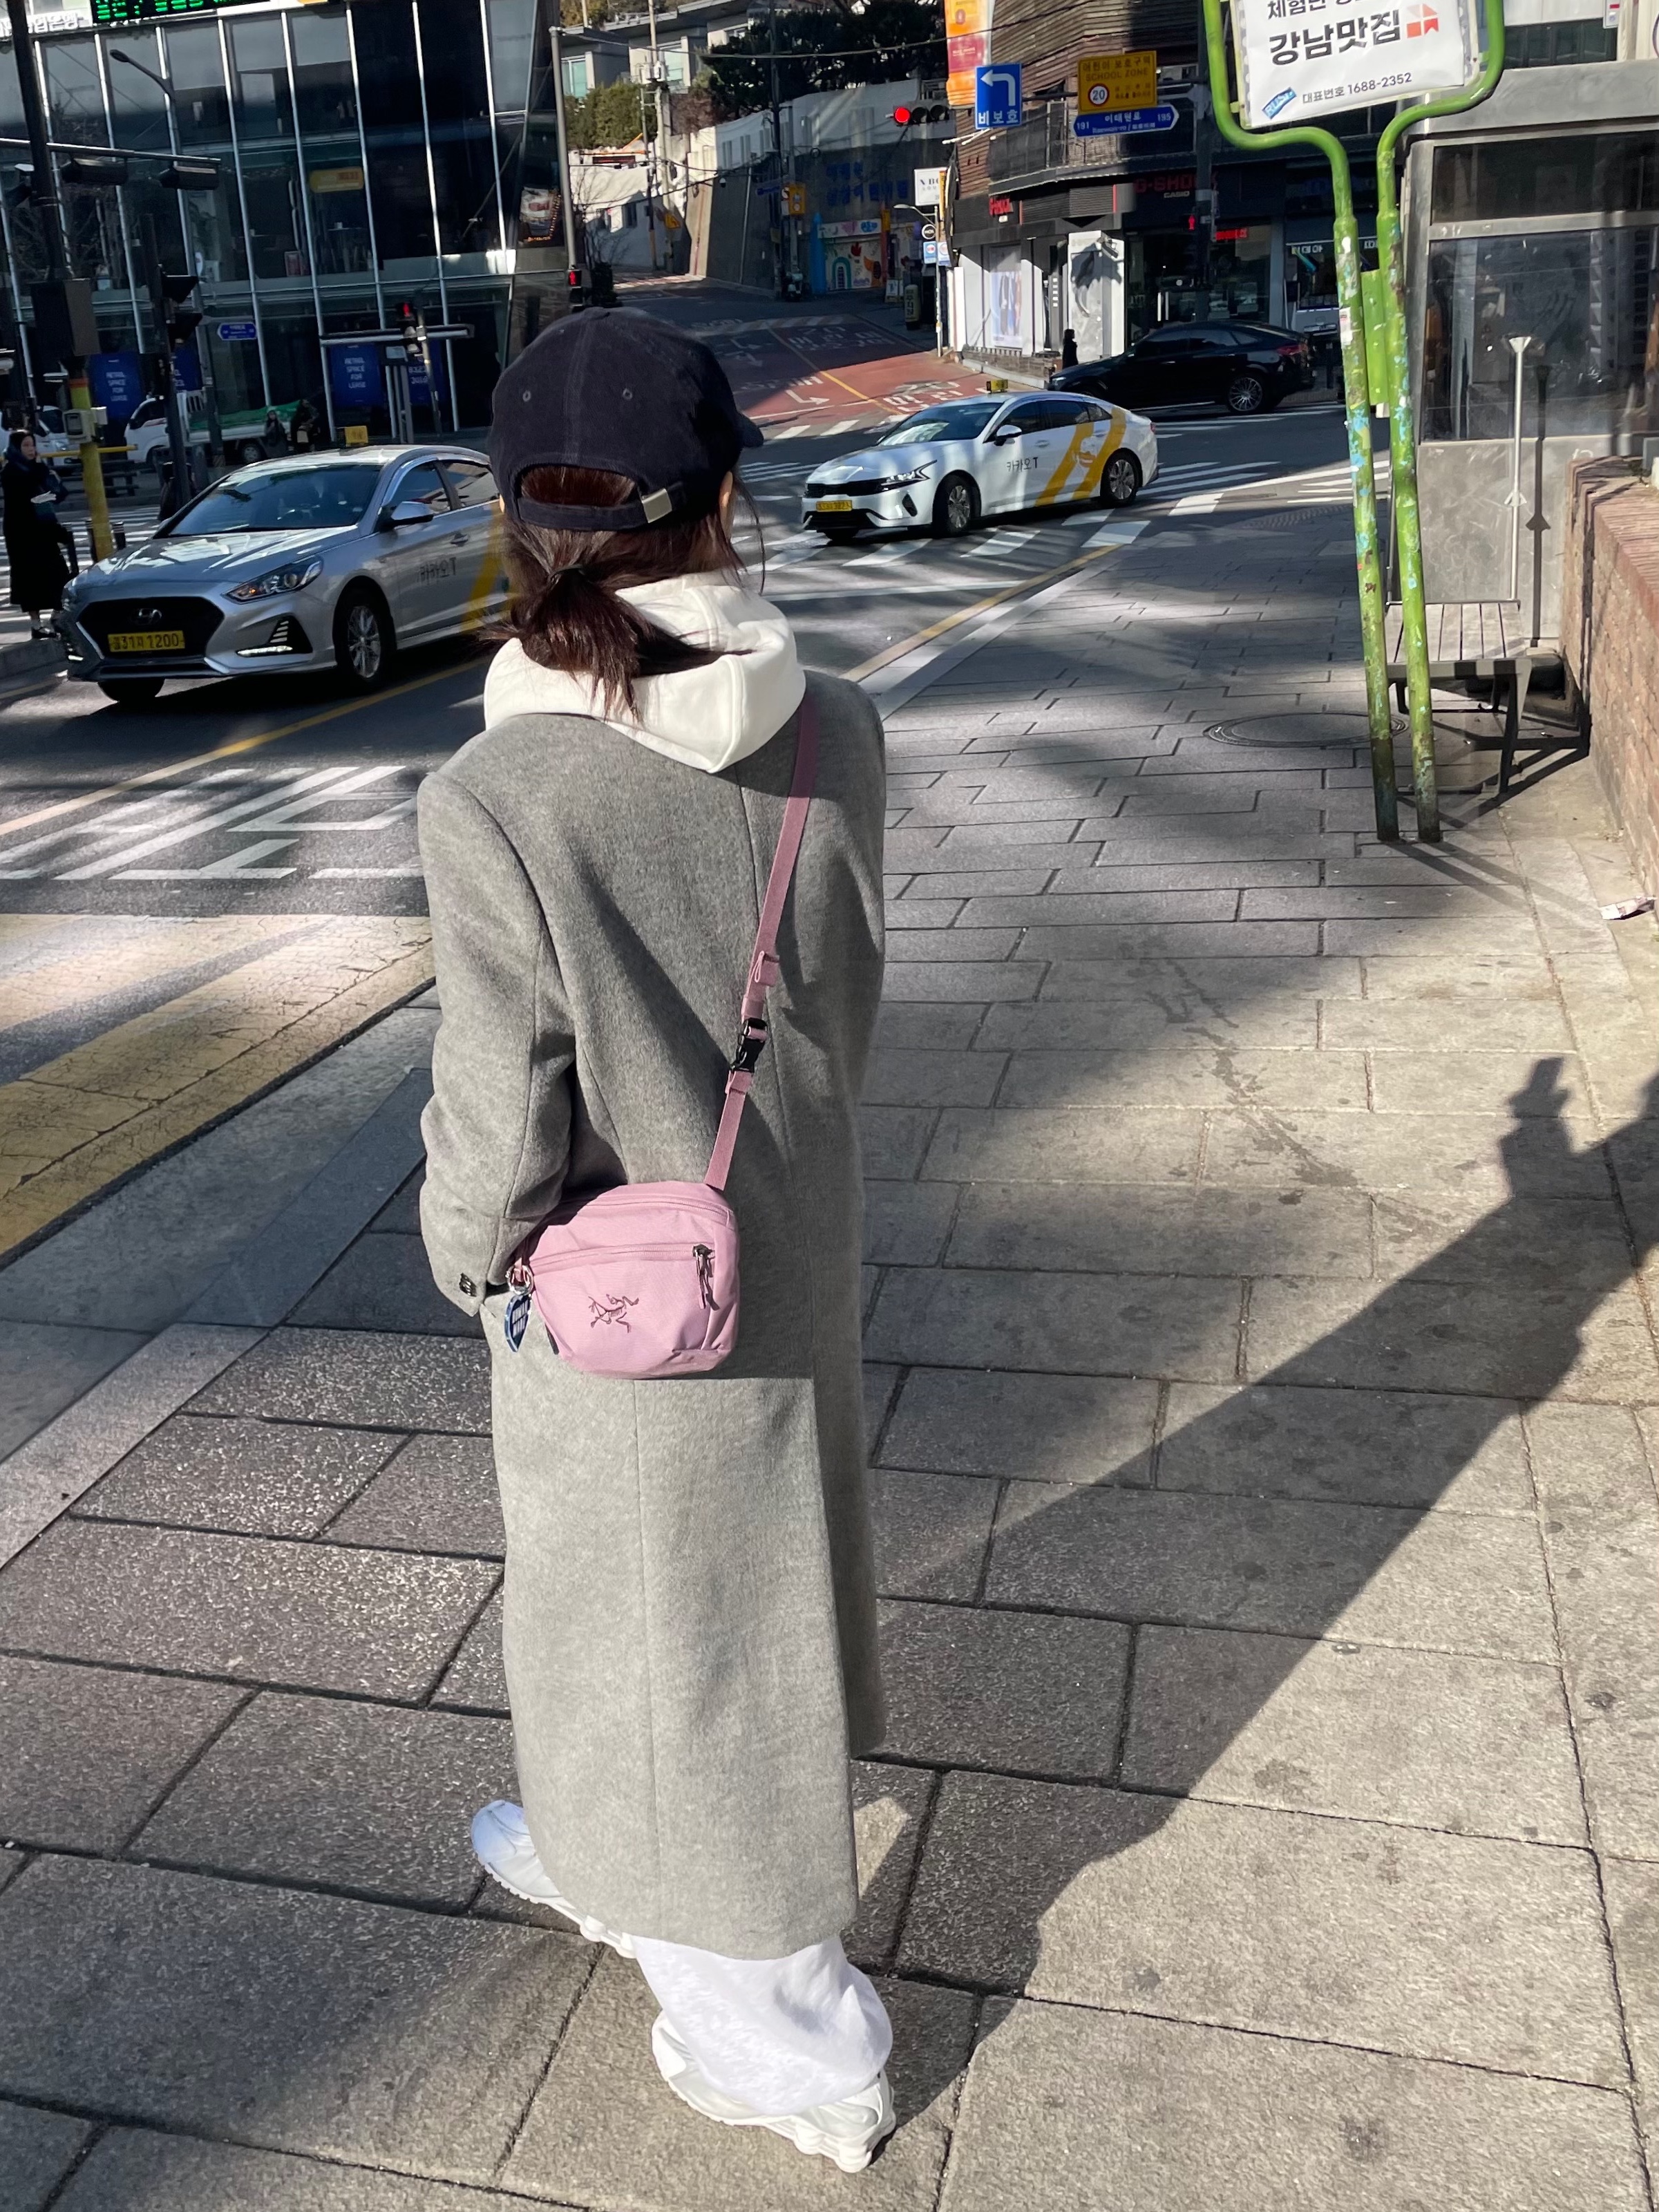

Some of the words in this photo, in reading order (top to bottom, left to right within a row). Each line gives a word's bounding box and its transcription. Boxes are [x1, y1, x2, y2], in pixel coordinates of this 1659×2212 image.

[1269, 9, 1401, 66] 강남맛집
[1115, 55, 1151, 69] 보호구역
[1086, 70, 1122, 82] SCHOOL
[1125, 68, 1149, 78] ZONE
[1092, 89, 1106, 101] 20
[1302, 86, 1345, 104] 대표번호
[1348, 72, 1412, 95] 1688-2352
[978, 109, 1018, 126] 비보호
[1104, 111, 1141, 124] 이태원로
[1076, 121, 1090, 131] 191
[1164, 190, 1191, 198] CASIO
[147, 633, 179, 649] 1200
